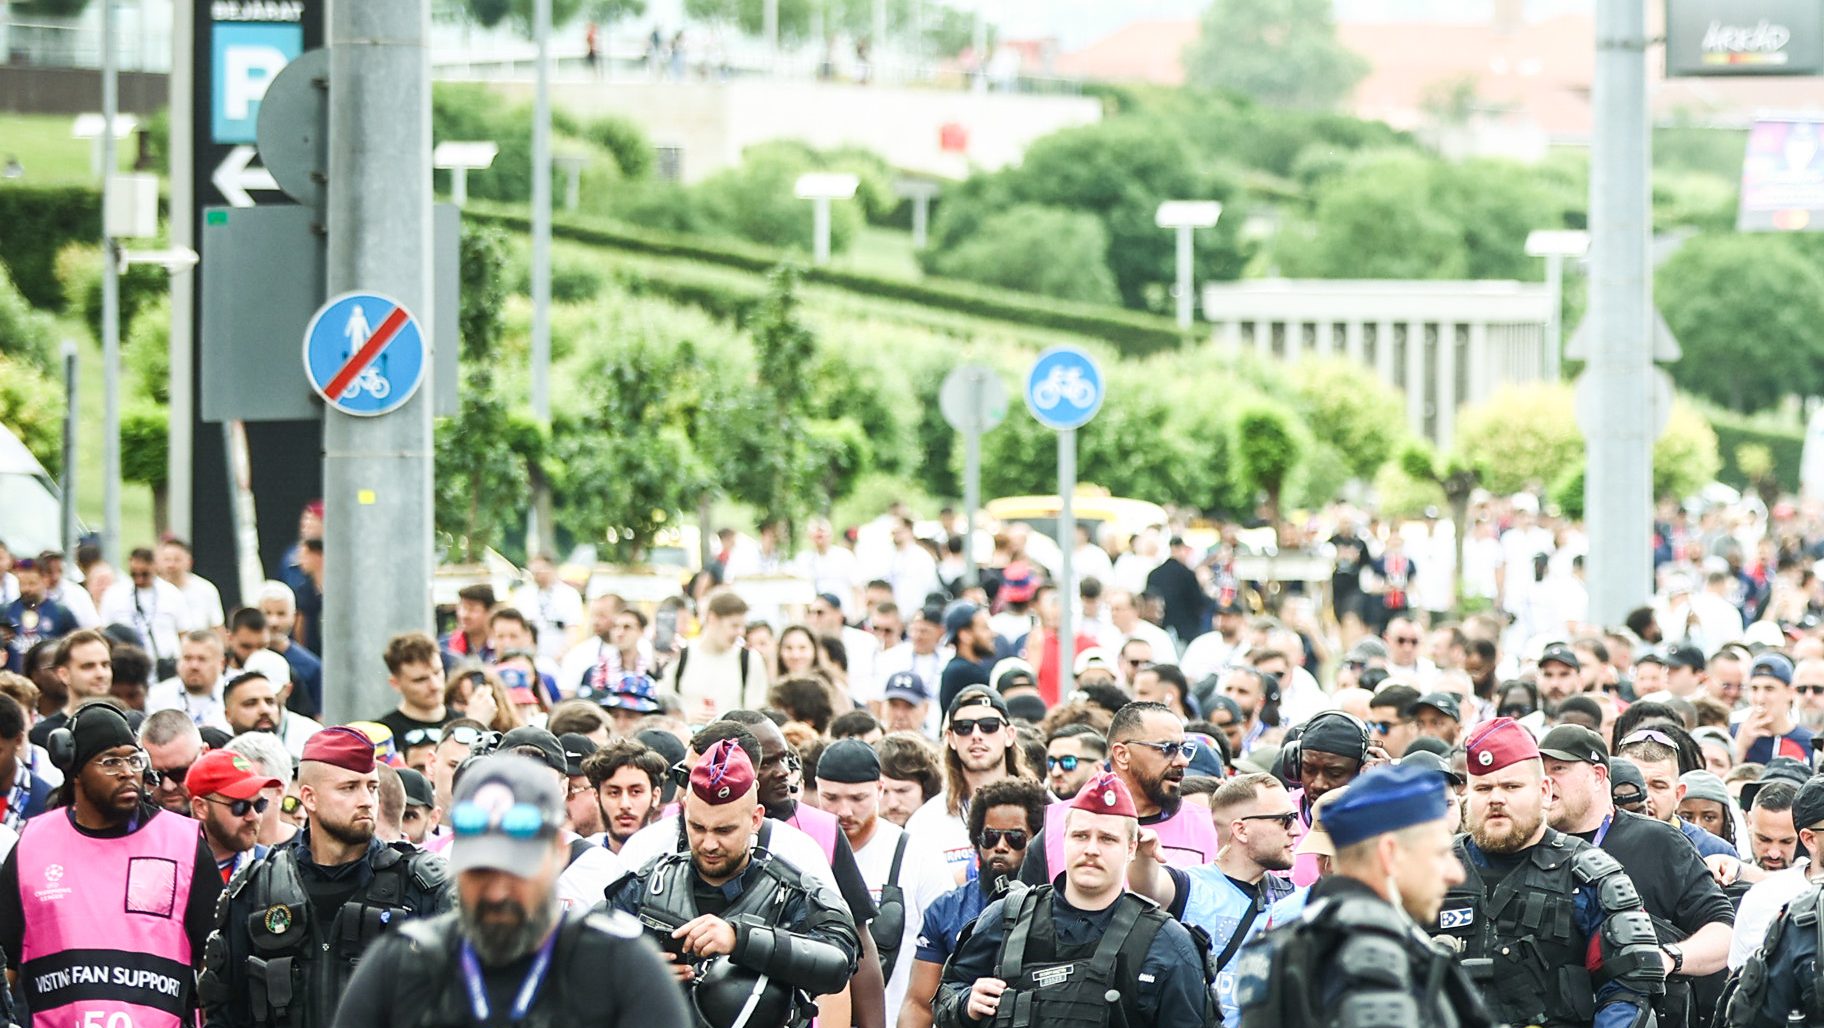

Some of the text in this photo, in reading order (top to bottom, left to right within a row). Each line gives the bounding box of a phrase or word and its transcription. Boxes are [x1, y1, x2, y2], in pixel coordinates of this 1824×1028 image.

[224, 46, 288, 120] P
[72, 966, 109, 984] FAN
[112, 967, 180, 998] SUPPORT
